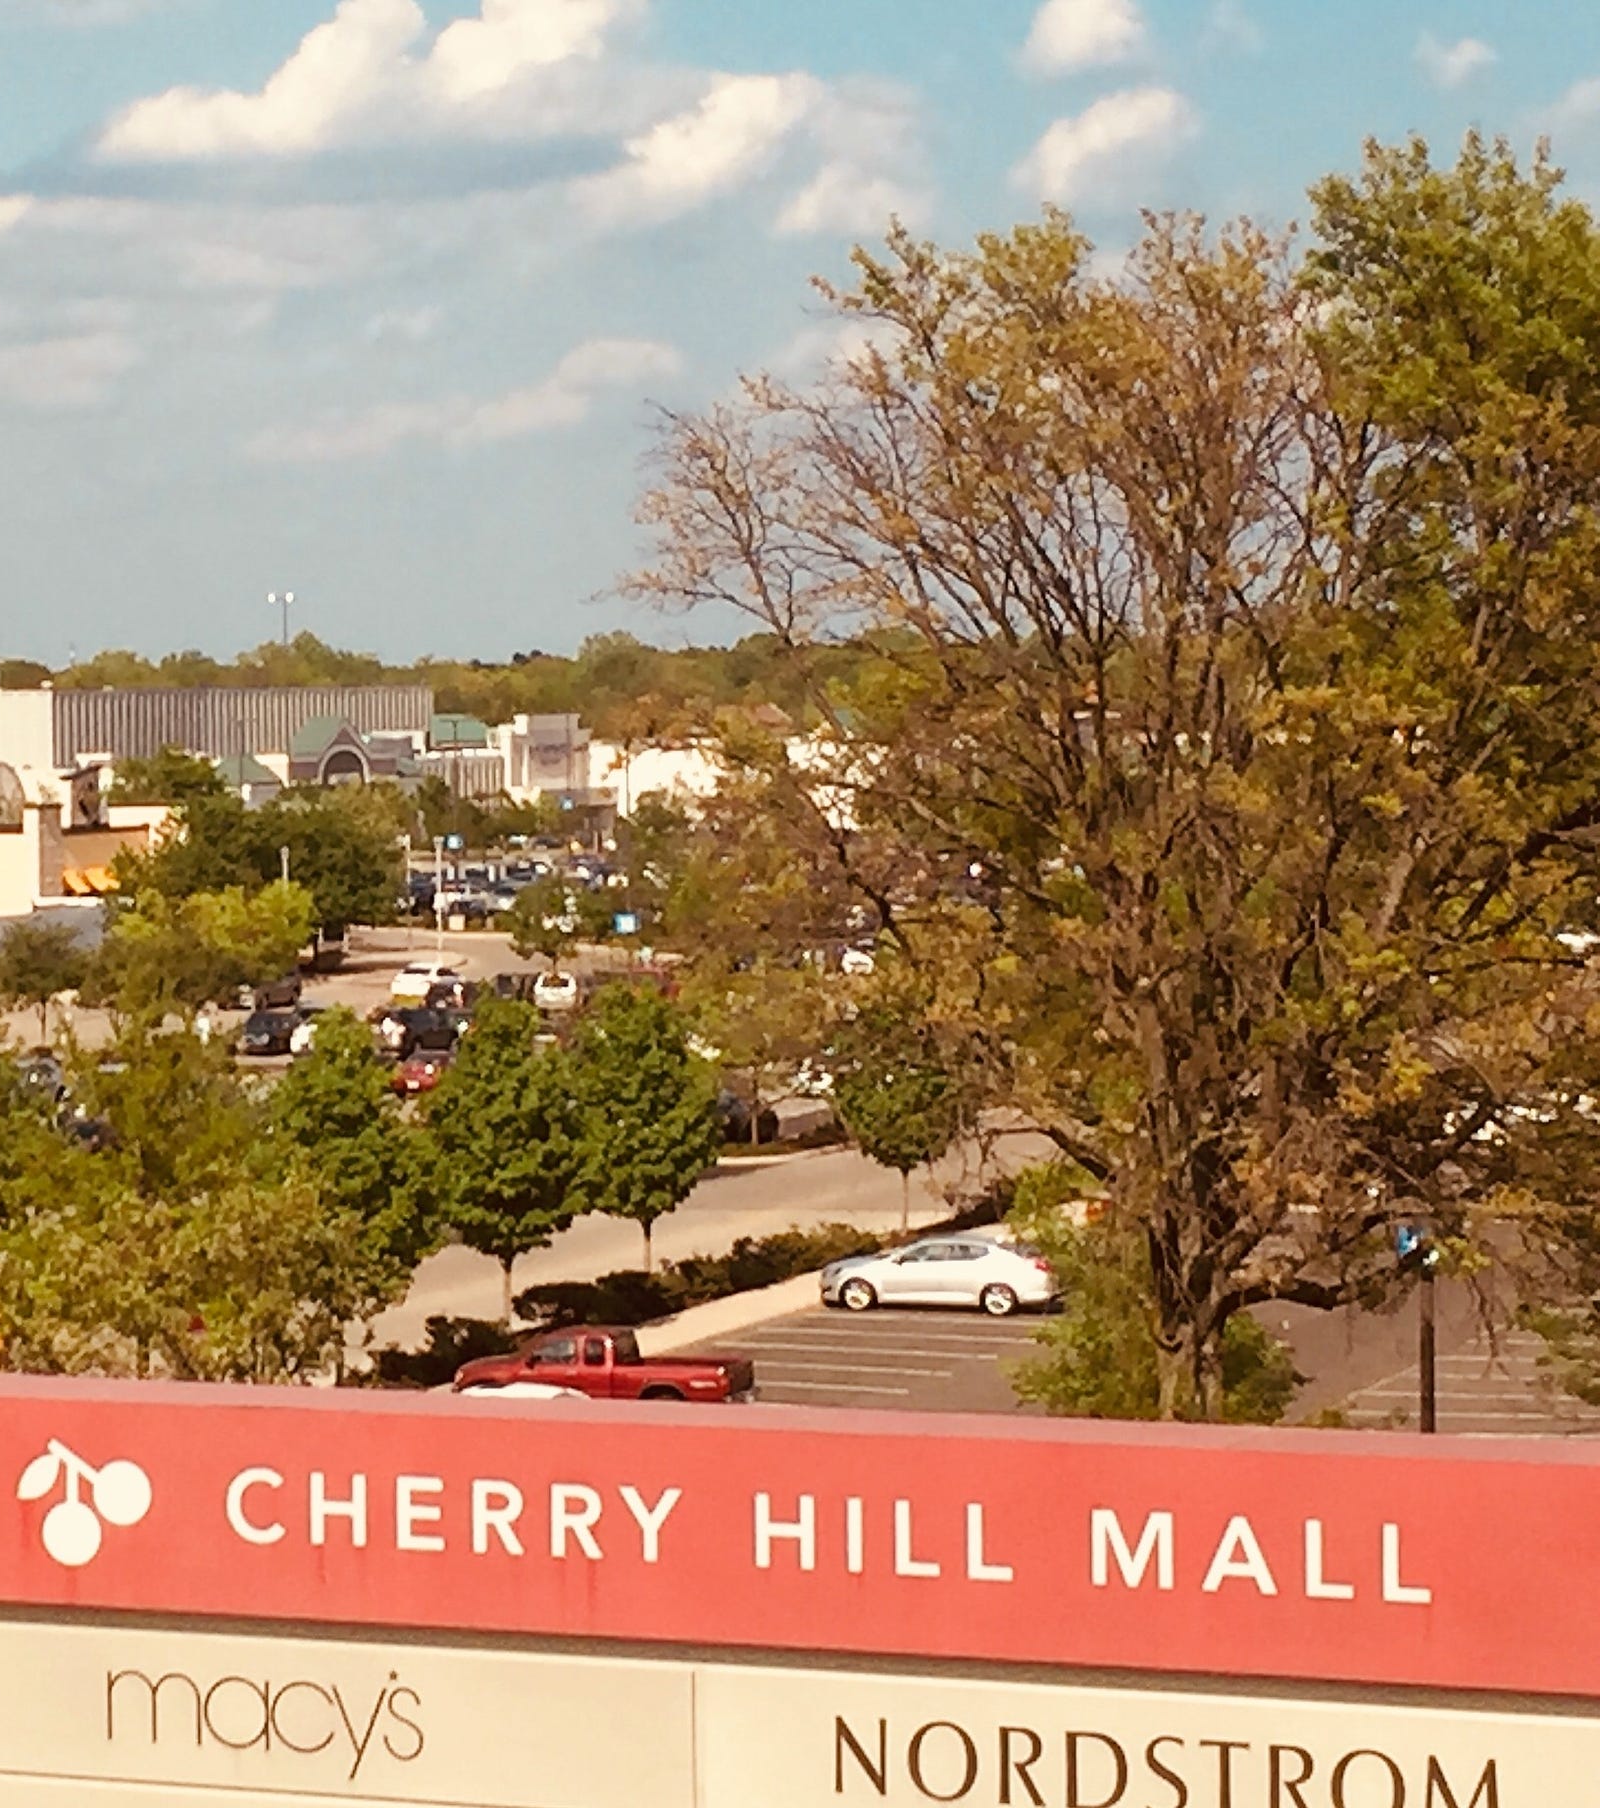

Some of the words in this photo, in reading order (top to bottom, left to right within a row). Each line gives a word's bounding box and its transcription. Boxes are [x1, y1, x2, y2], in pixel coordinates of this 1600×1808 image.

[225, 1466, 683, 1563] CHERRY
[753, 1491, 1014, 1582] HILL
[1090, 1508, 1432, 1604] MALL
[106, 1669, 424, 1780] macy's
[833, 1715, 1500, 1808] NORDSTROM
